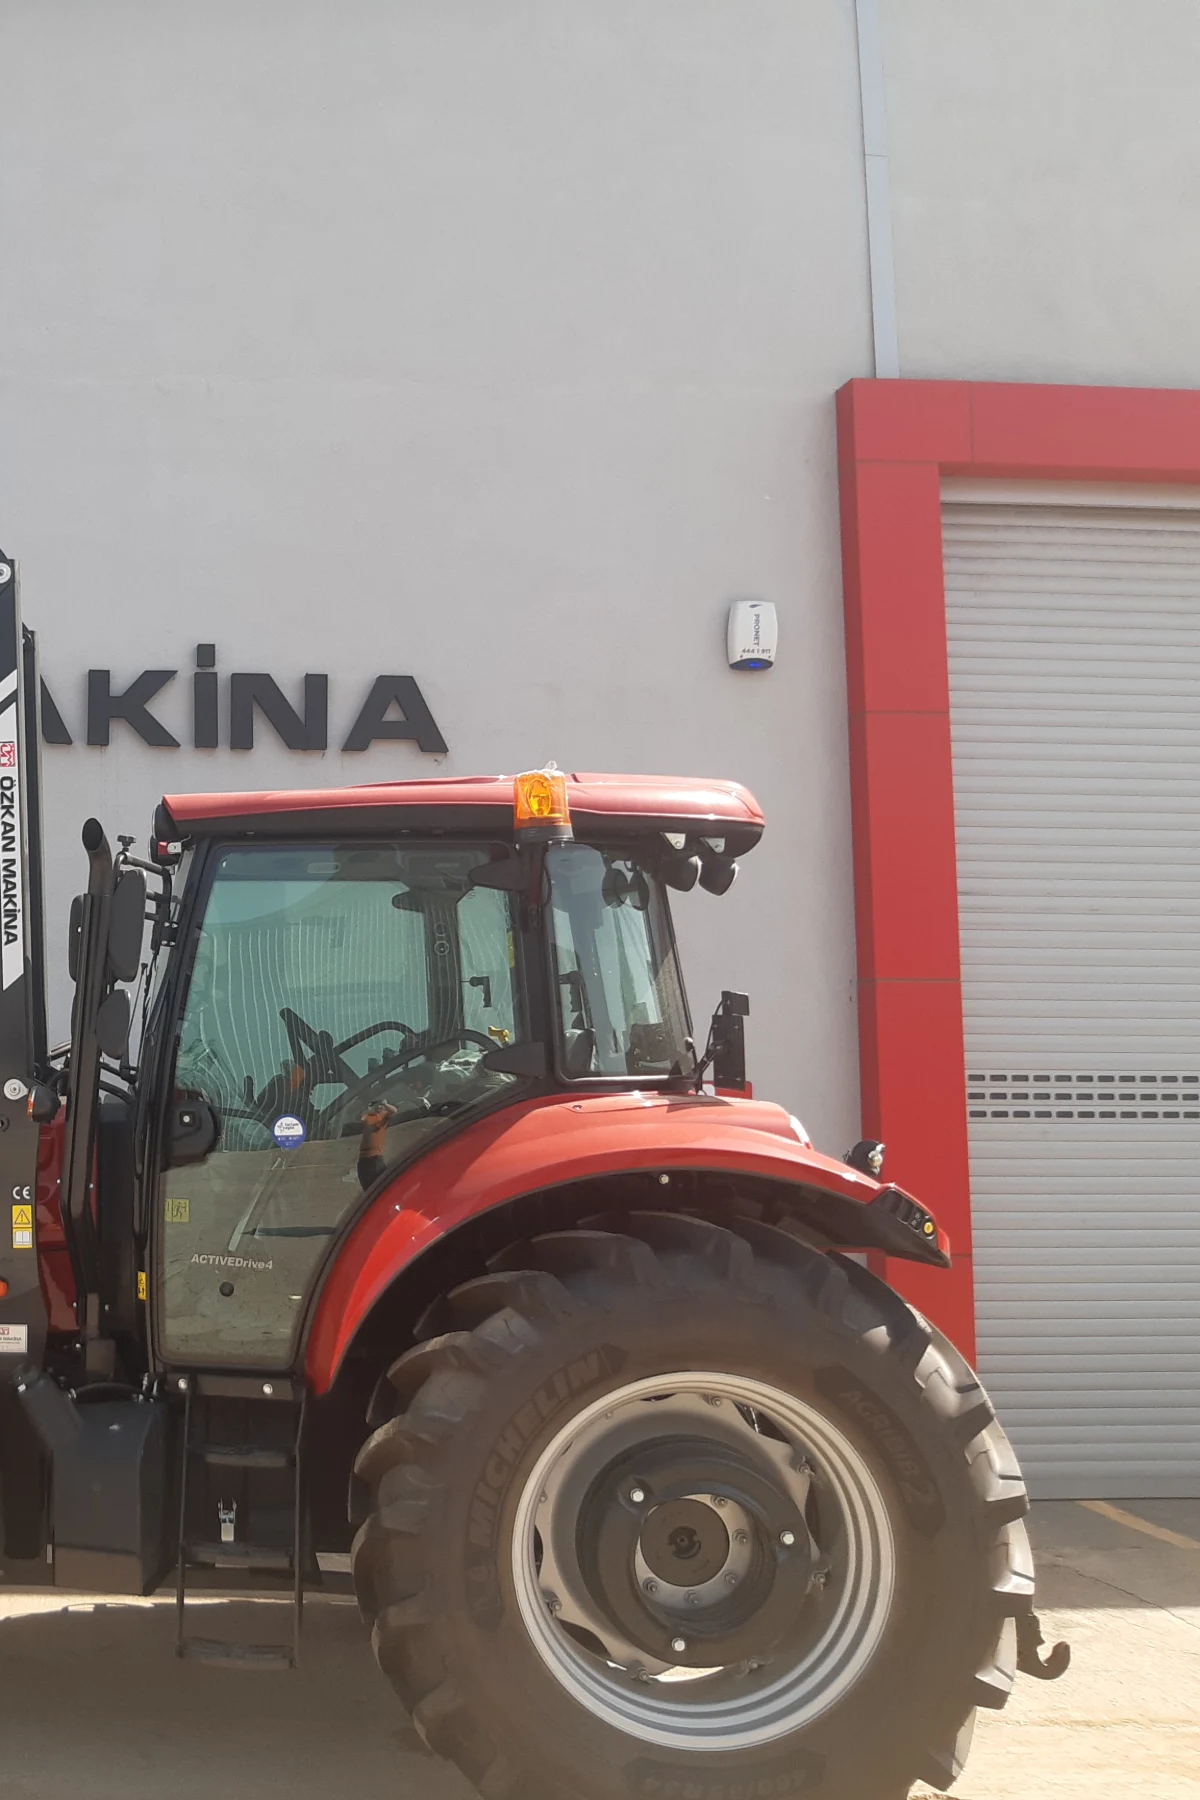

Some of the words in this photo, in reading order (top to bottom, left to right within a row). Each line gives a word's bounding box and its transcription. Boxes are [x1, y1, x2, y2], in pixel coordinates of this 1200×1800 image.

[753, 613, 761, 646] PRONET
[0, 776, 16, 853] ÖZKAN
[2, 858, 21, 947] MAKİNA
[12, 1186, 30, 1199] CE
[191, 1253, 273, 1270] ACTIVEDrive4
[467, 1351, 601, 1548] MICHELIN
